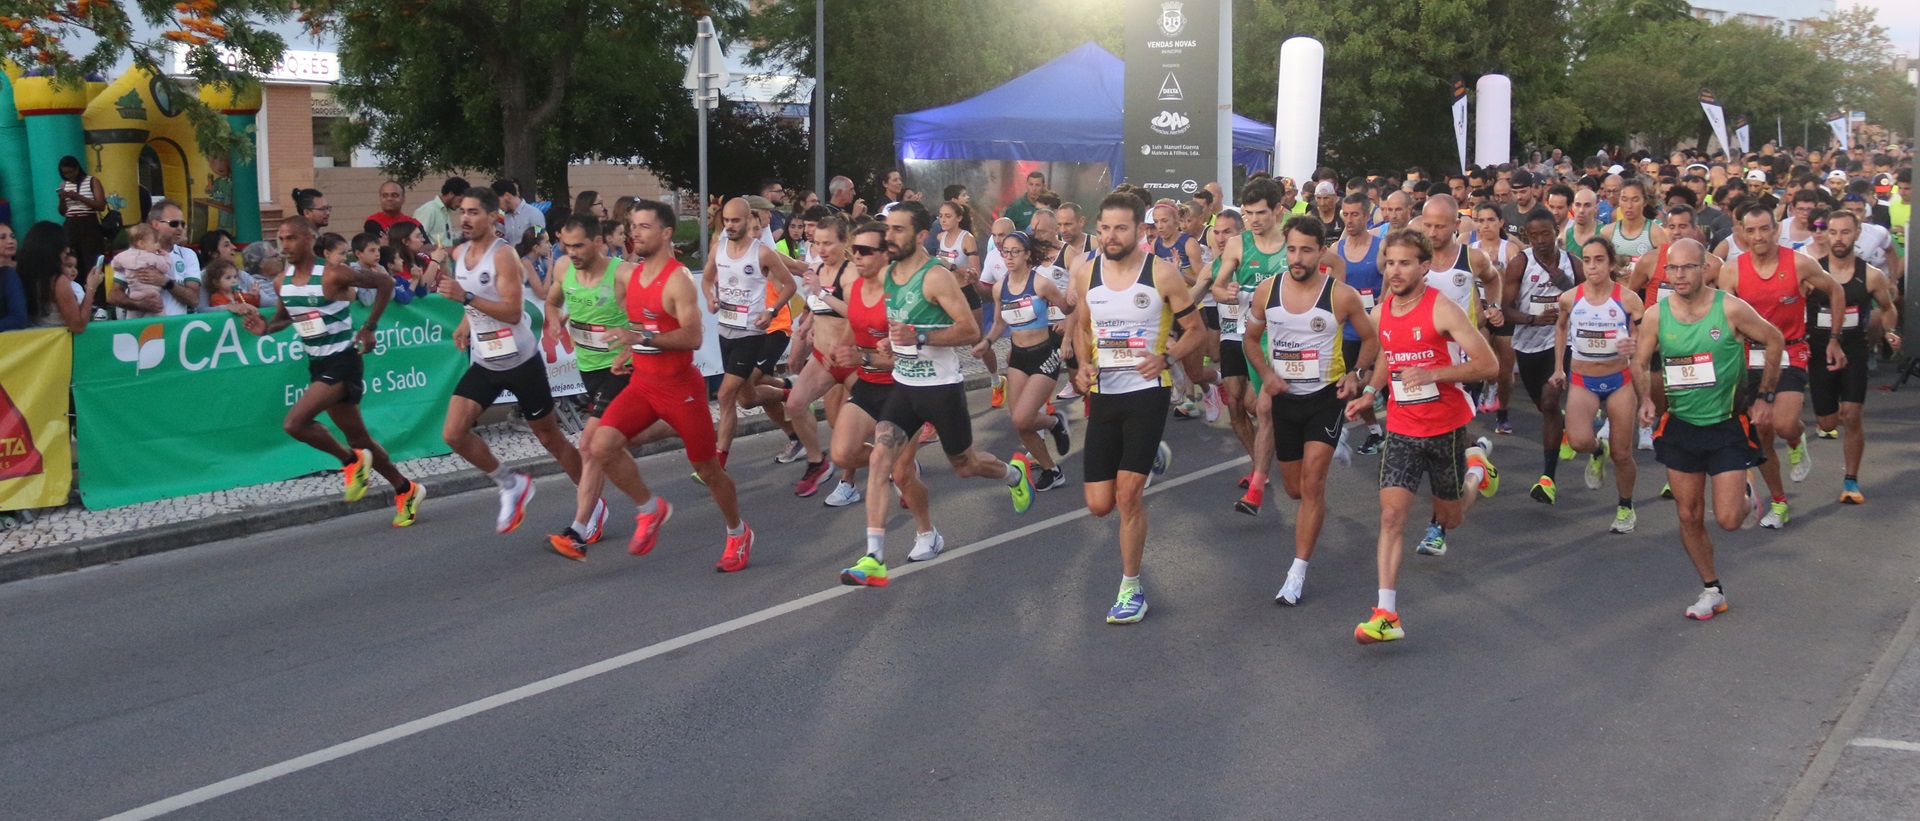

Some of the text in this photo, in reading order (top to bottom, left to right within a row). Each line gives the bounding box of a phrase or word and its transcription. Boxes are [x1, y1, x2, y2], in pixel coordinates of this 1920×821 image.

[1174, 40, 1197, 48] NOVAS
[1013, 309, 1022, 318] 11
[1228, 306, 1239, 314] 30
[179, 318, 249, 371] CA
[374, 319, 442, 356] grícola
[1587, 339, 1607, 348] 359
[1112, 349, 1134, 359] 254
[1395, 349, 1435, 361] navarra
[1693, 354, 1710, 362] 10KM
[1284, 361, 1305, 373] 255
[1681, 365, 1696, 378] 82
[371, 377, 382, 393] e
[386, 366, 427, 392] Sado
